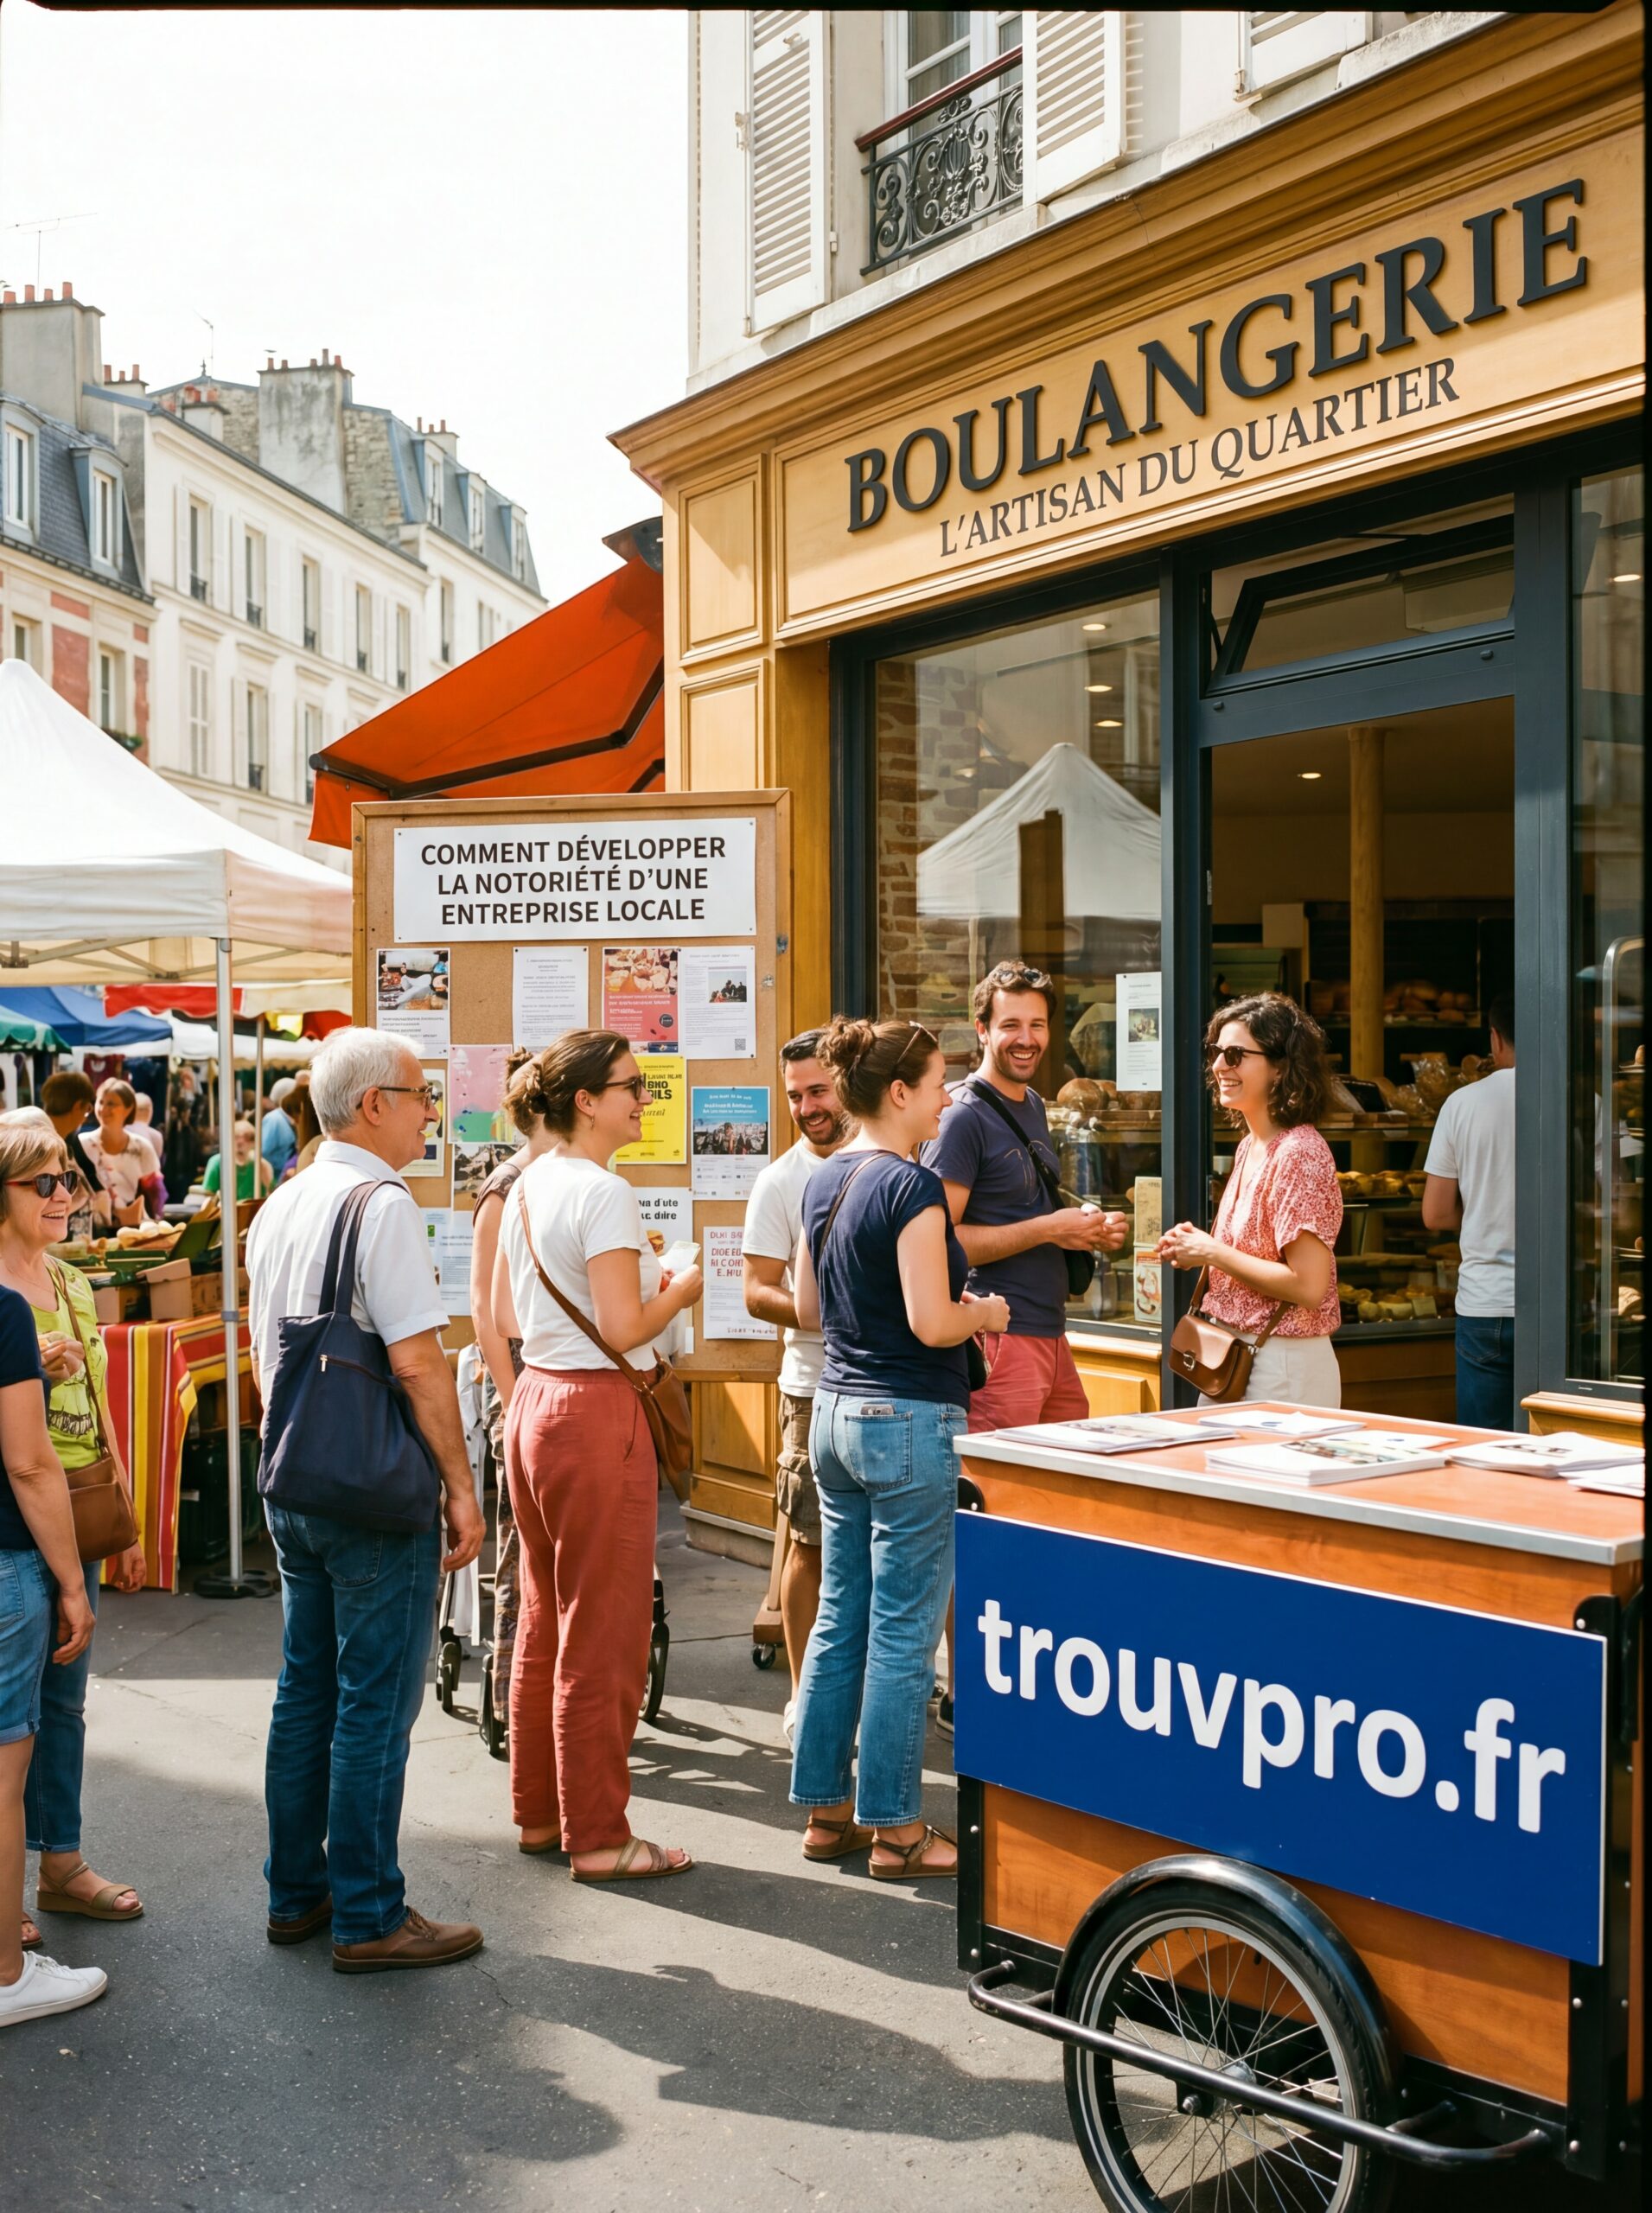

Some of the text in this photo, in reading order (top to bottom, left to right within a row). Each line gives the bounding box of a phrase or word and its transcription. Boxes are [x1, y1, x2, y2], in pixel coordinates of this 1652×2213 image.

[845, 178, 1589, 533] BOULANGERIE
[939, 358, 1460, 558] L’ARTISAN DU QUARTIER
[421, 834, 726, 865] COMMENT DÉVELOPPER
[438, 864, 708, 895] LA NOTORIÉTÉ D’UNE
[442, 898, 705, 925] ENTREPRISE LOCALE
[978, 1599, 1566, 1834] trouvpro.fr
